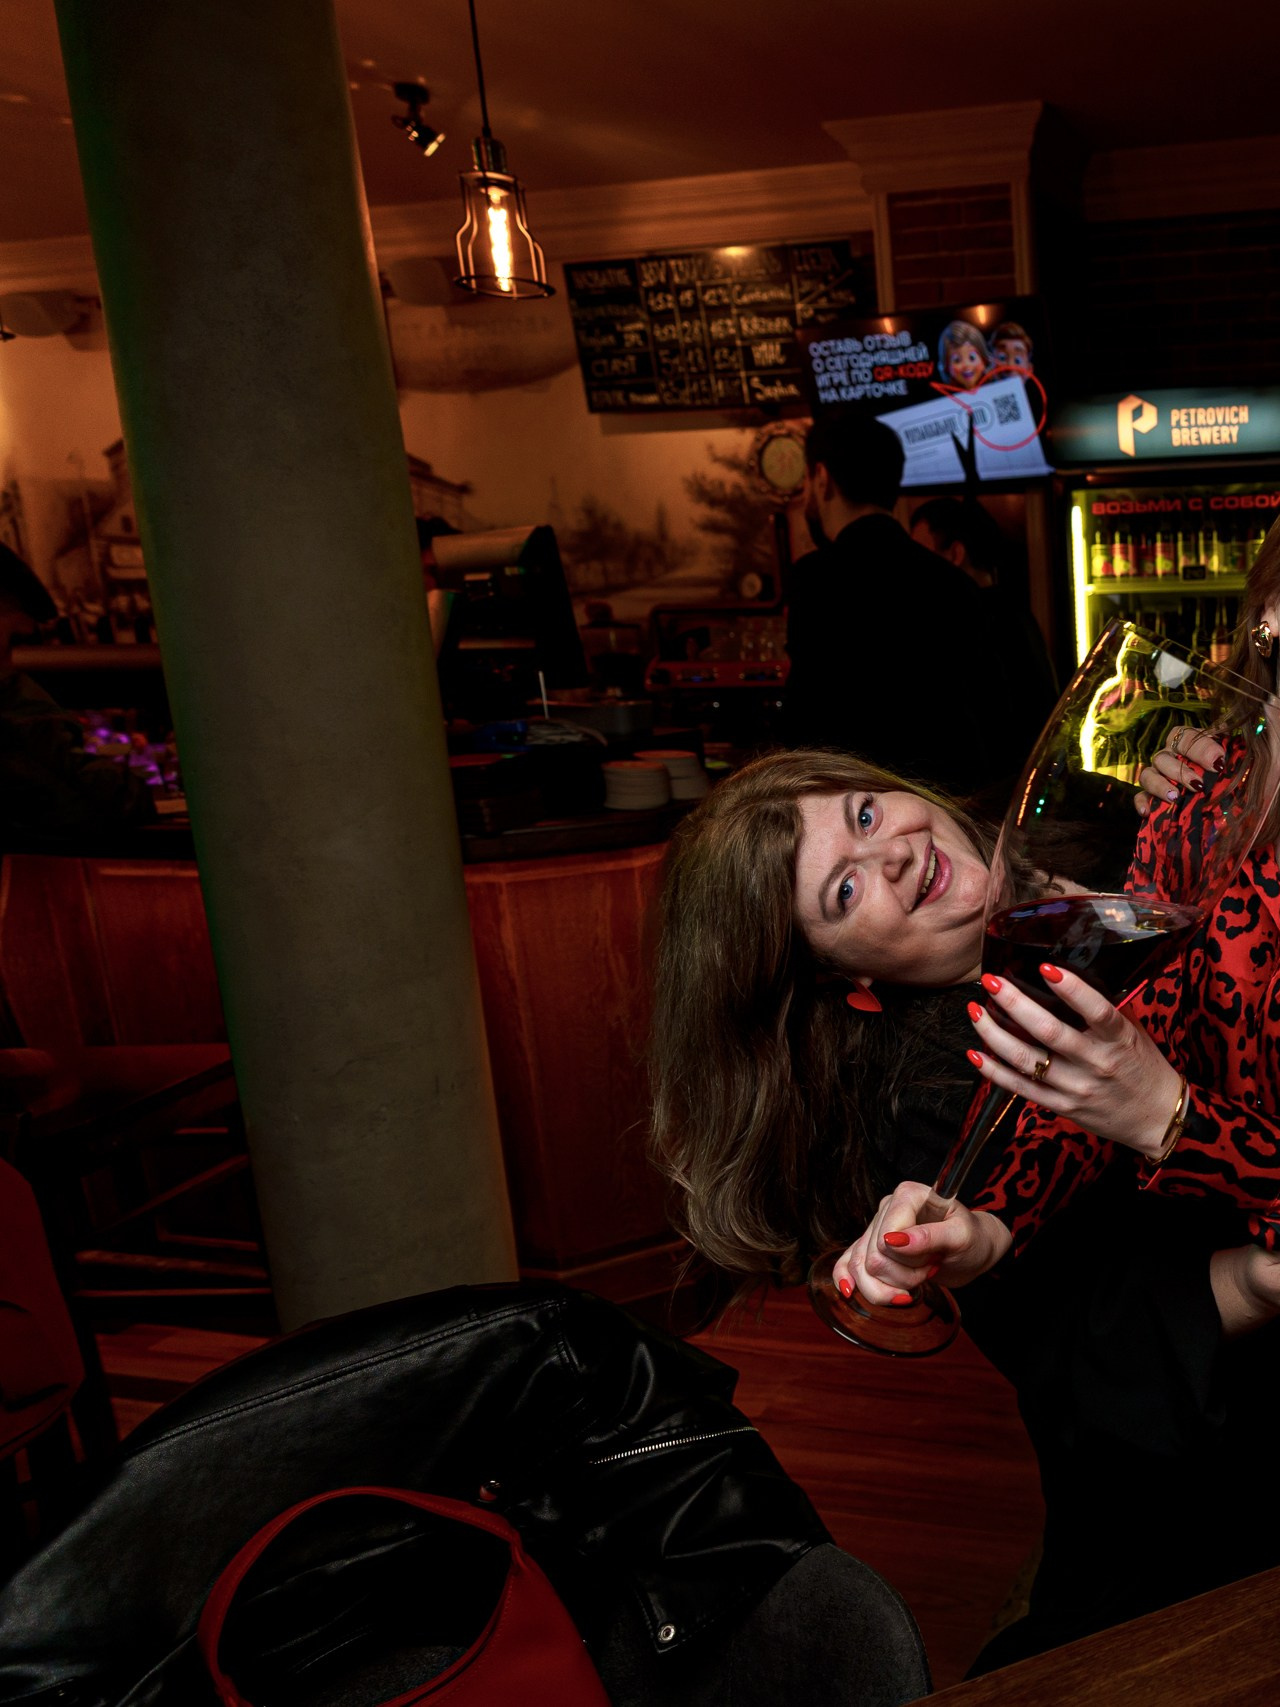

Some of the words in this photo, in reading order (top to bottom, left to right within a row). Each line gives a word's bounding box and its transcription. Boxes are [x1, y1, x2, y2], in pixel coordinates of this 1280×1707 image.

[809, 337, 863, 358] ОСТАВЬ
[863, 330, 912, 352] ОТЗЫВ
[825, 341, 930, 371] СЕГОДНЯШНЕЙ
[815, 370, 850, 389] ИГРЕ
[850, 367, 873, 384] ПО
[818, 386, 840, 404] НА
[840, 378, 909, 402] КАРТОЧКЕ
[1171, 405, 1249, 427] PETROVICH
[1171, 426, 1240, 447] BREWERY
[1092, 497, 1183, 516] ВОЗЬМИ
[1189, 497, 1204, 511] С
